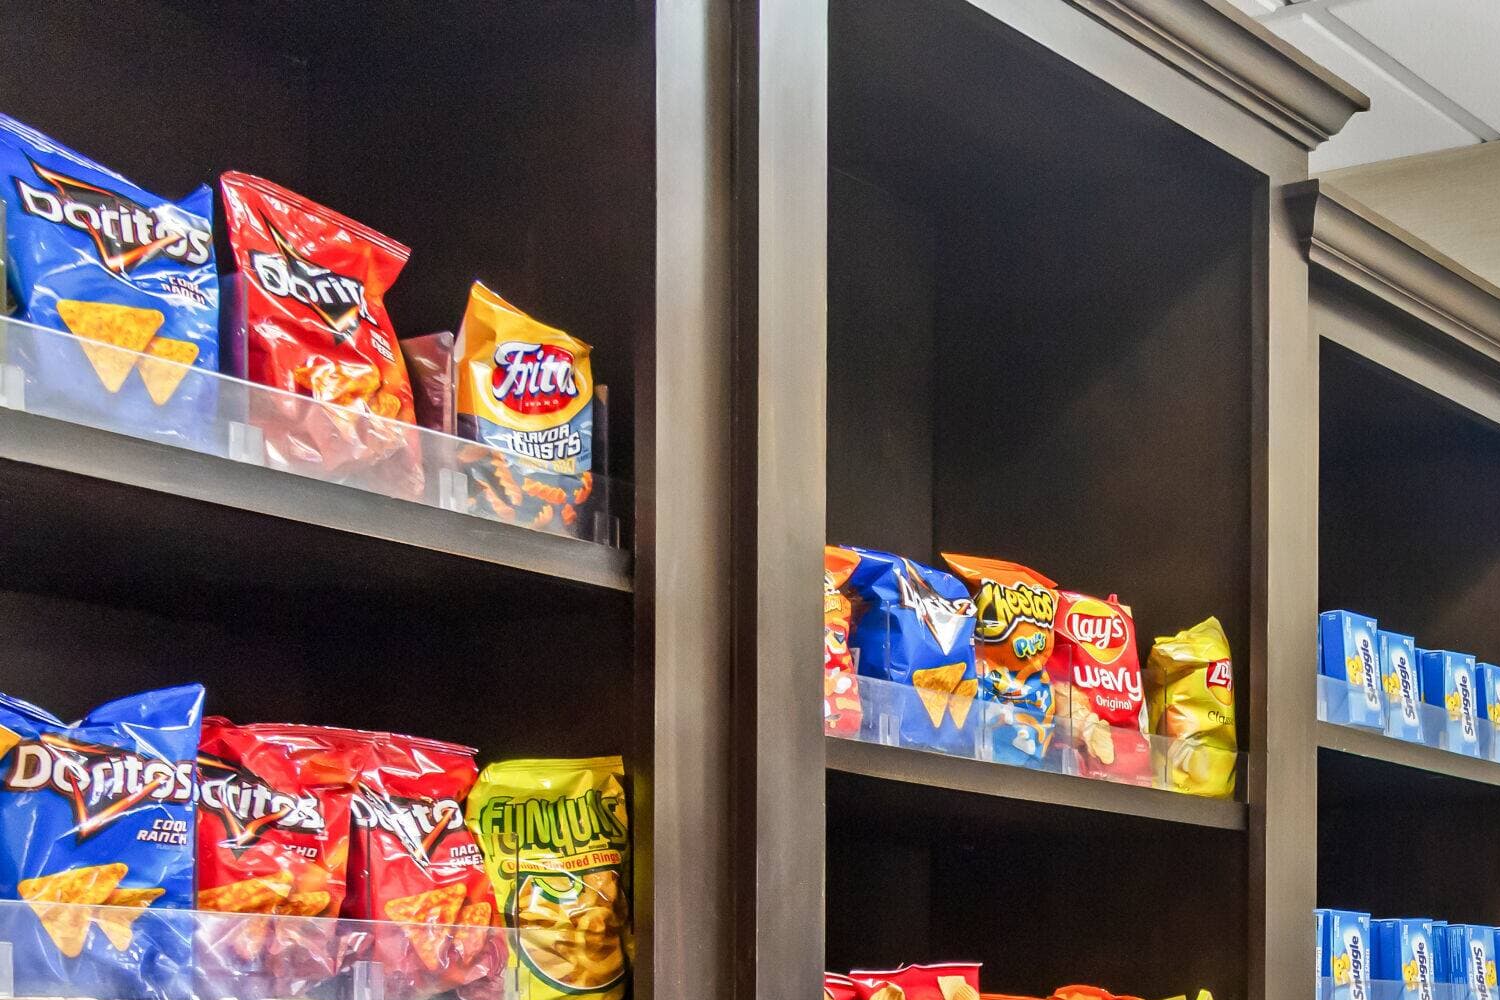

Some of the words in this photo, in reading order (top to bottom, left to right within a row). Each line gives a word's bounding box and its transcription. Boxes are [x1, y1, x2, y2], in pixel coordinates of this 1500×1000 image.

[19, 179, 212, 265] Doritos
[253, 252, 378, 327] Dorit
[507, 432, 582, 462] TWISTS
[512, 424, 570, 444] FLAVOR
[975, 583, 1054, 640] Cheetos
[1071, 612, 1124, 649] Lay's
[1073, 665, 1142, 700] wavy
[1361, 639, 1378, 705] Snuggle
[1400, 656, 1416, 721] Snuggle
[1096, 694, 1133, 711] Original
[1458, 675, 1474, 738] Snuggle
[9, 744, 194, 803] Doritos
[194, 772, 325, 829] oritos
[136, 829, 187, 845] RANCH
[152, 819, 187, 832] COOL
[450, 842, 480, 857] NACH
[450, 856, 484, 868] CHEES
[593, 851, 620, 865] Rings
